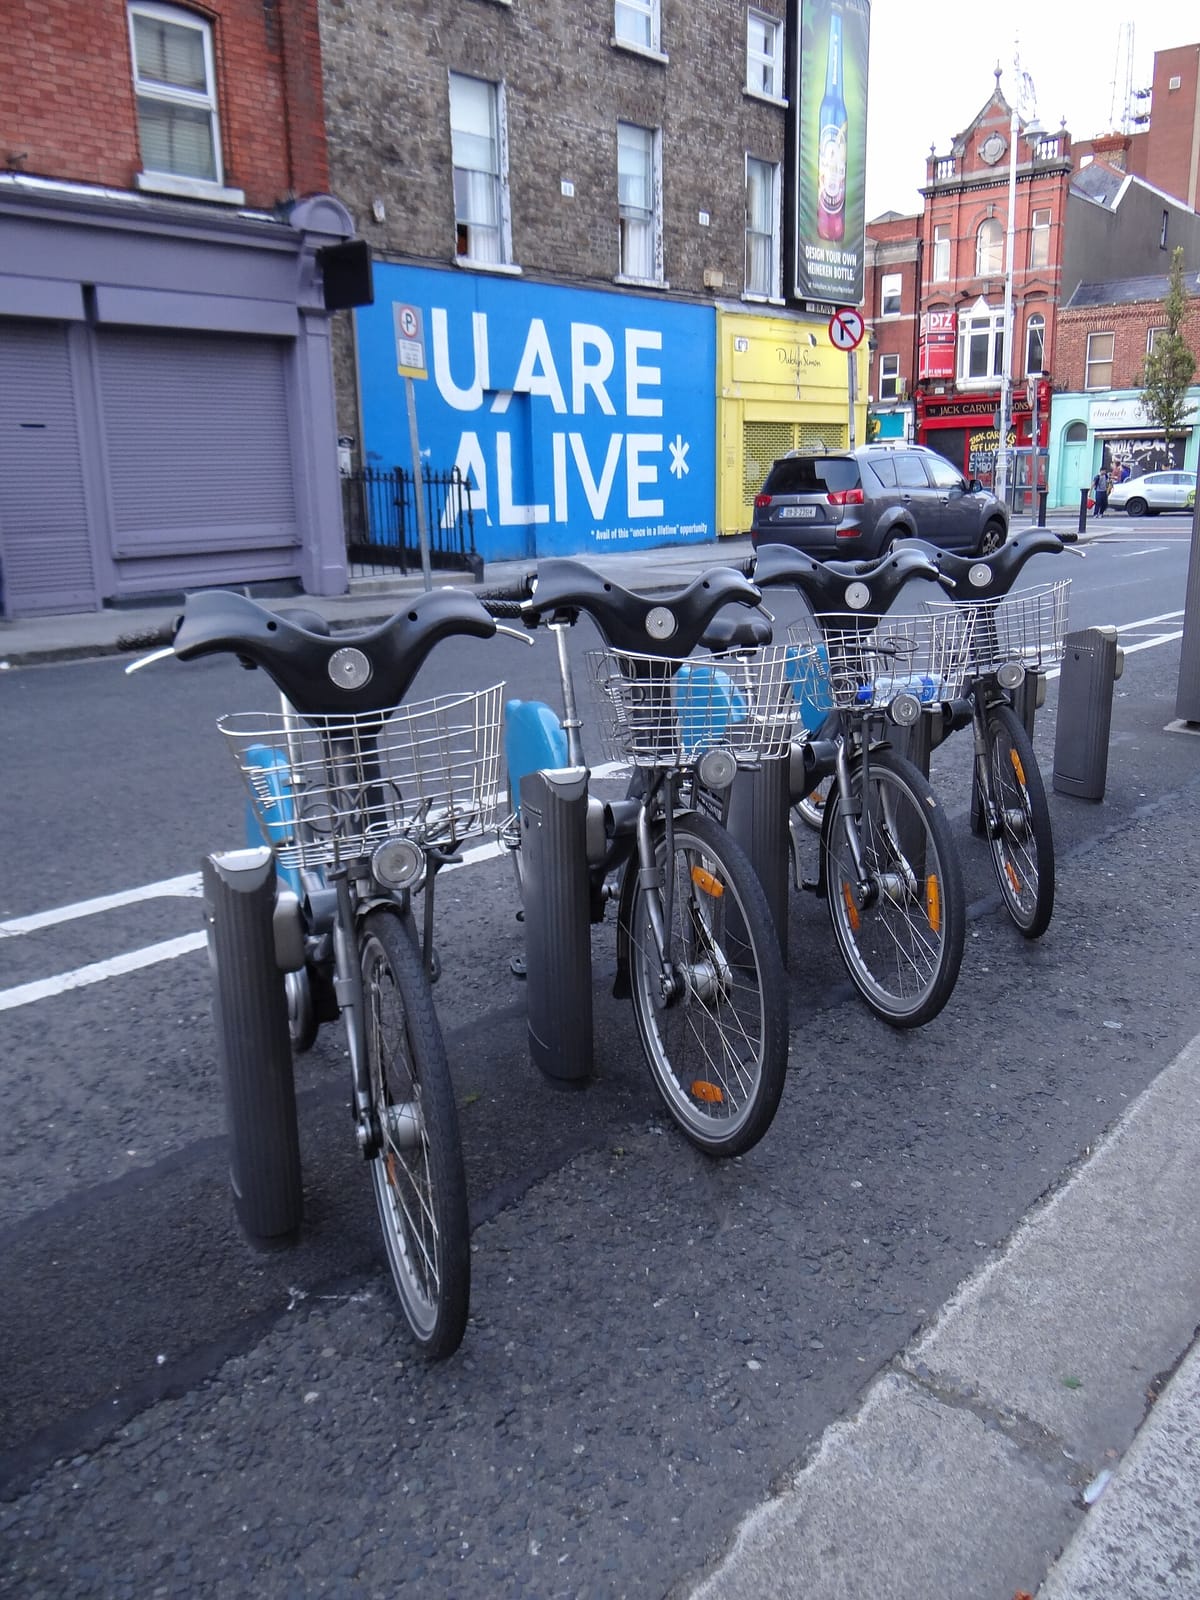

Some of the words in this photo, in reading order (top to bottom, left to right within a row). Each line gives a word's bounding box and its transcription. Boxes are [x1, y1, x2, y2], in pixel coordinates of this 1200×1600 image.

[805, 245, 825, 261] DESIGN
[825, 249, 841, 265] YOUR
[842, 252, 857, 267] OWN
[807, 261, 833, 278] HEINEKEN
[833, 266, 855, 281] BOTTLE.
[930, 313, 953, 327] DTZ
[431, 307, 490, 412] U
[489, 317, 663, 417] ARE
[940, 405, 960, 416] JACK
[969, 432, 987, 446] JACK
[970, 443, 984, 452] OFF
[611, 528, 617, 539] of
[618, 527, 629, 538] this
[646, 525, 653, 536] in
[680, 522, 708, 536] opportunity
